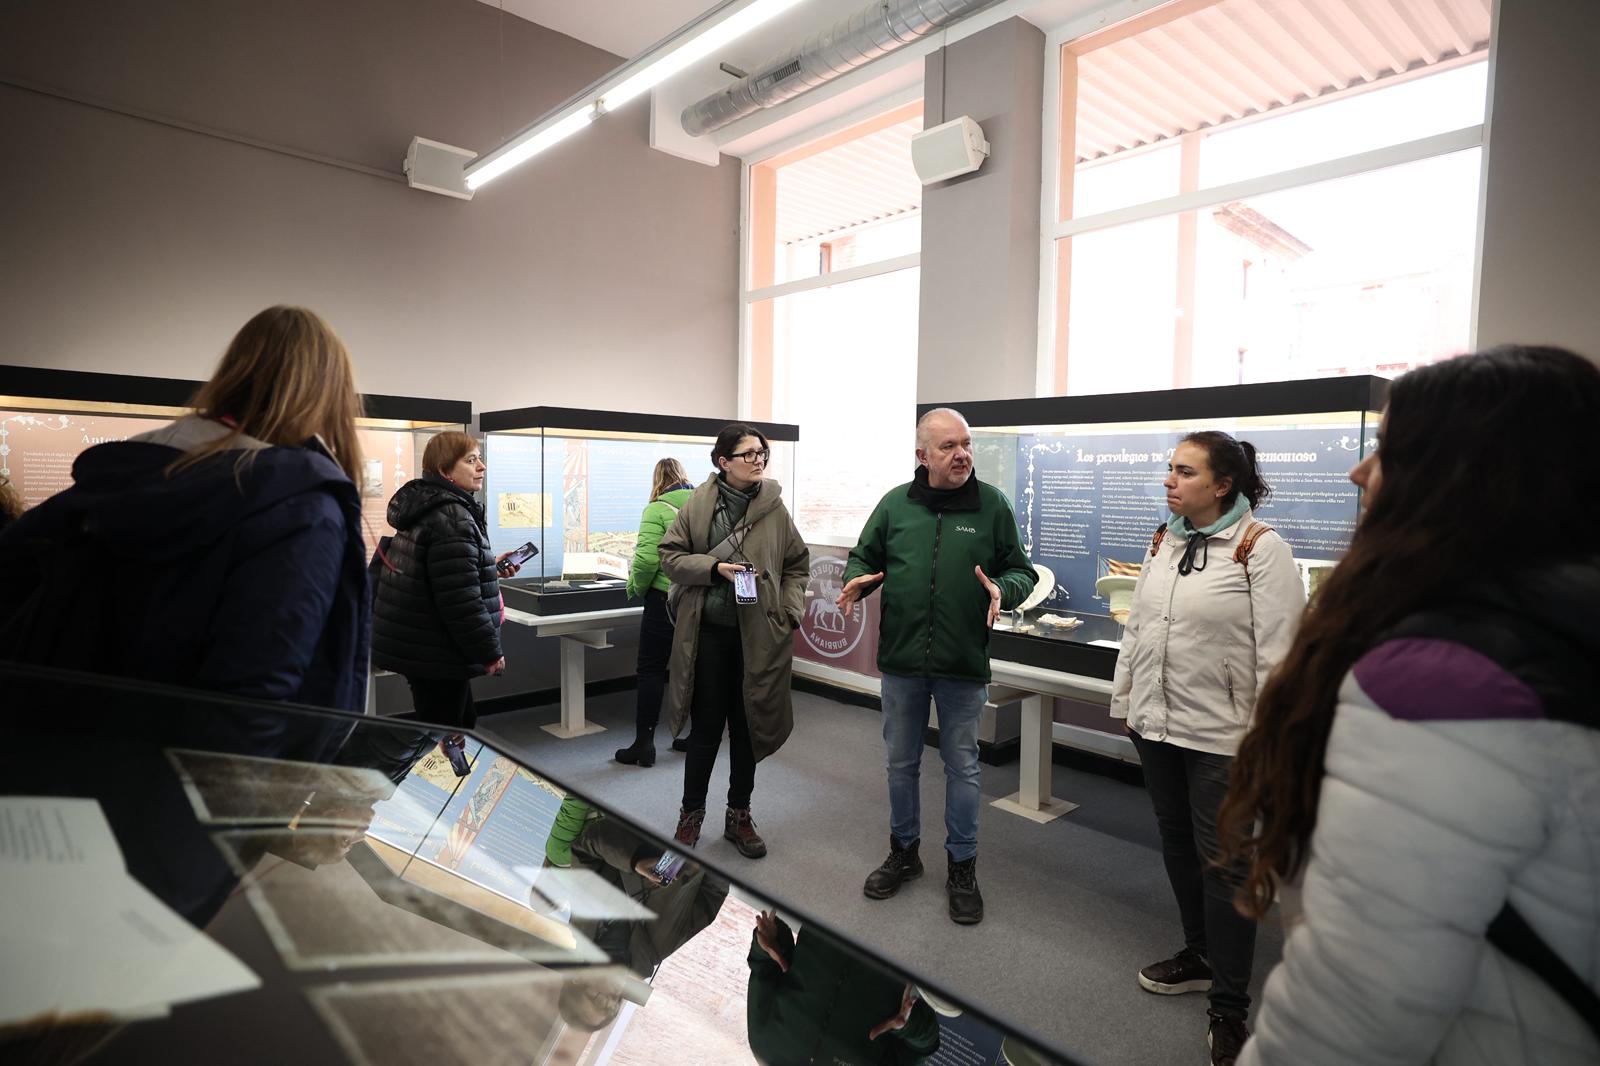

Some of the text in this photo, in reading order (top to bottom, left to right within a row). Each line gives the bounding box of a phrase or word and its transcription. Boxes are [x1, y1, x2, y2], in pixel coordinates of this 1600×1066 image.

[1076, 448, 1094, 463] Los
[1096, 448, 1149, 465] privilegios
[1151, 452, 1164, 463] de
